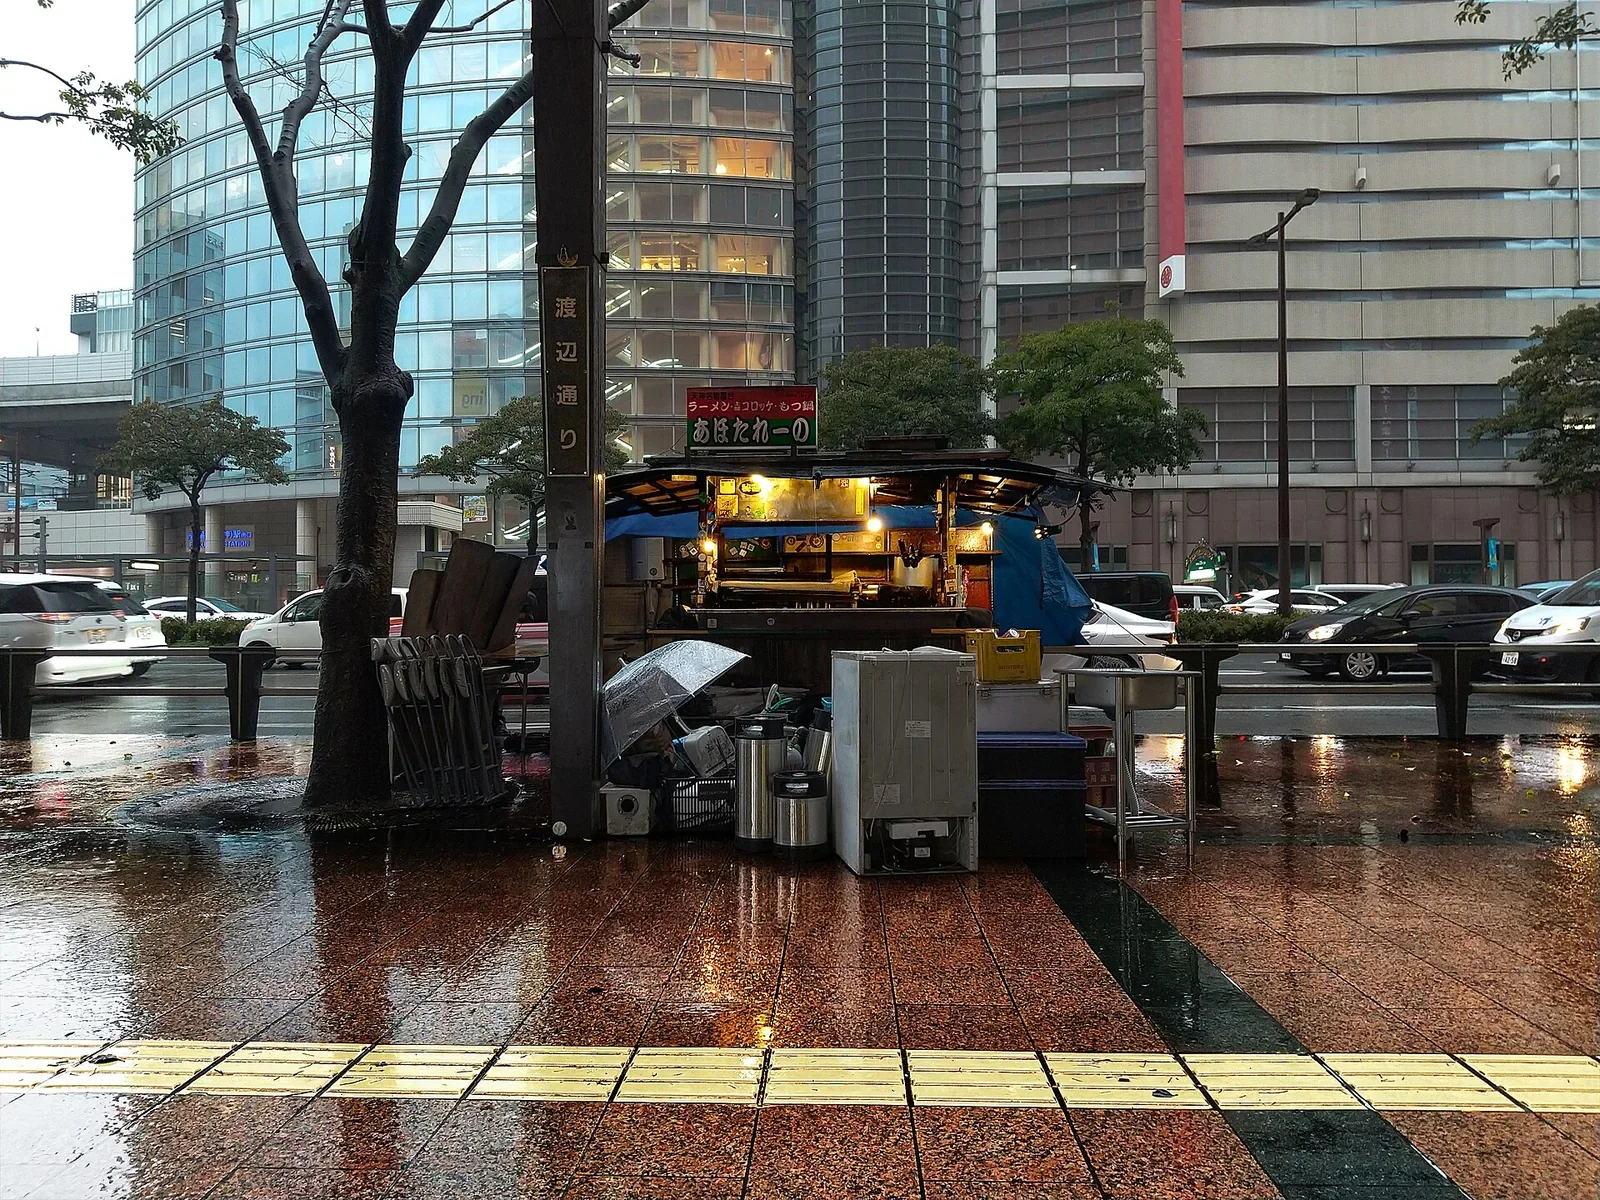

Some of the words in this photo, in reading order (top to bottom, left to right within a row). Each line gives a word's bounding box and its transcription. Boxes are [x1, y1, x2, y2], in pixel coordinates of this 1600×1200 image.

[555, 297, 578, 450] 渡辺通り
[692, 416, 810, 443] あほたれーの
